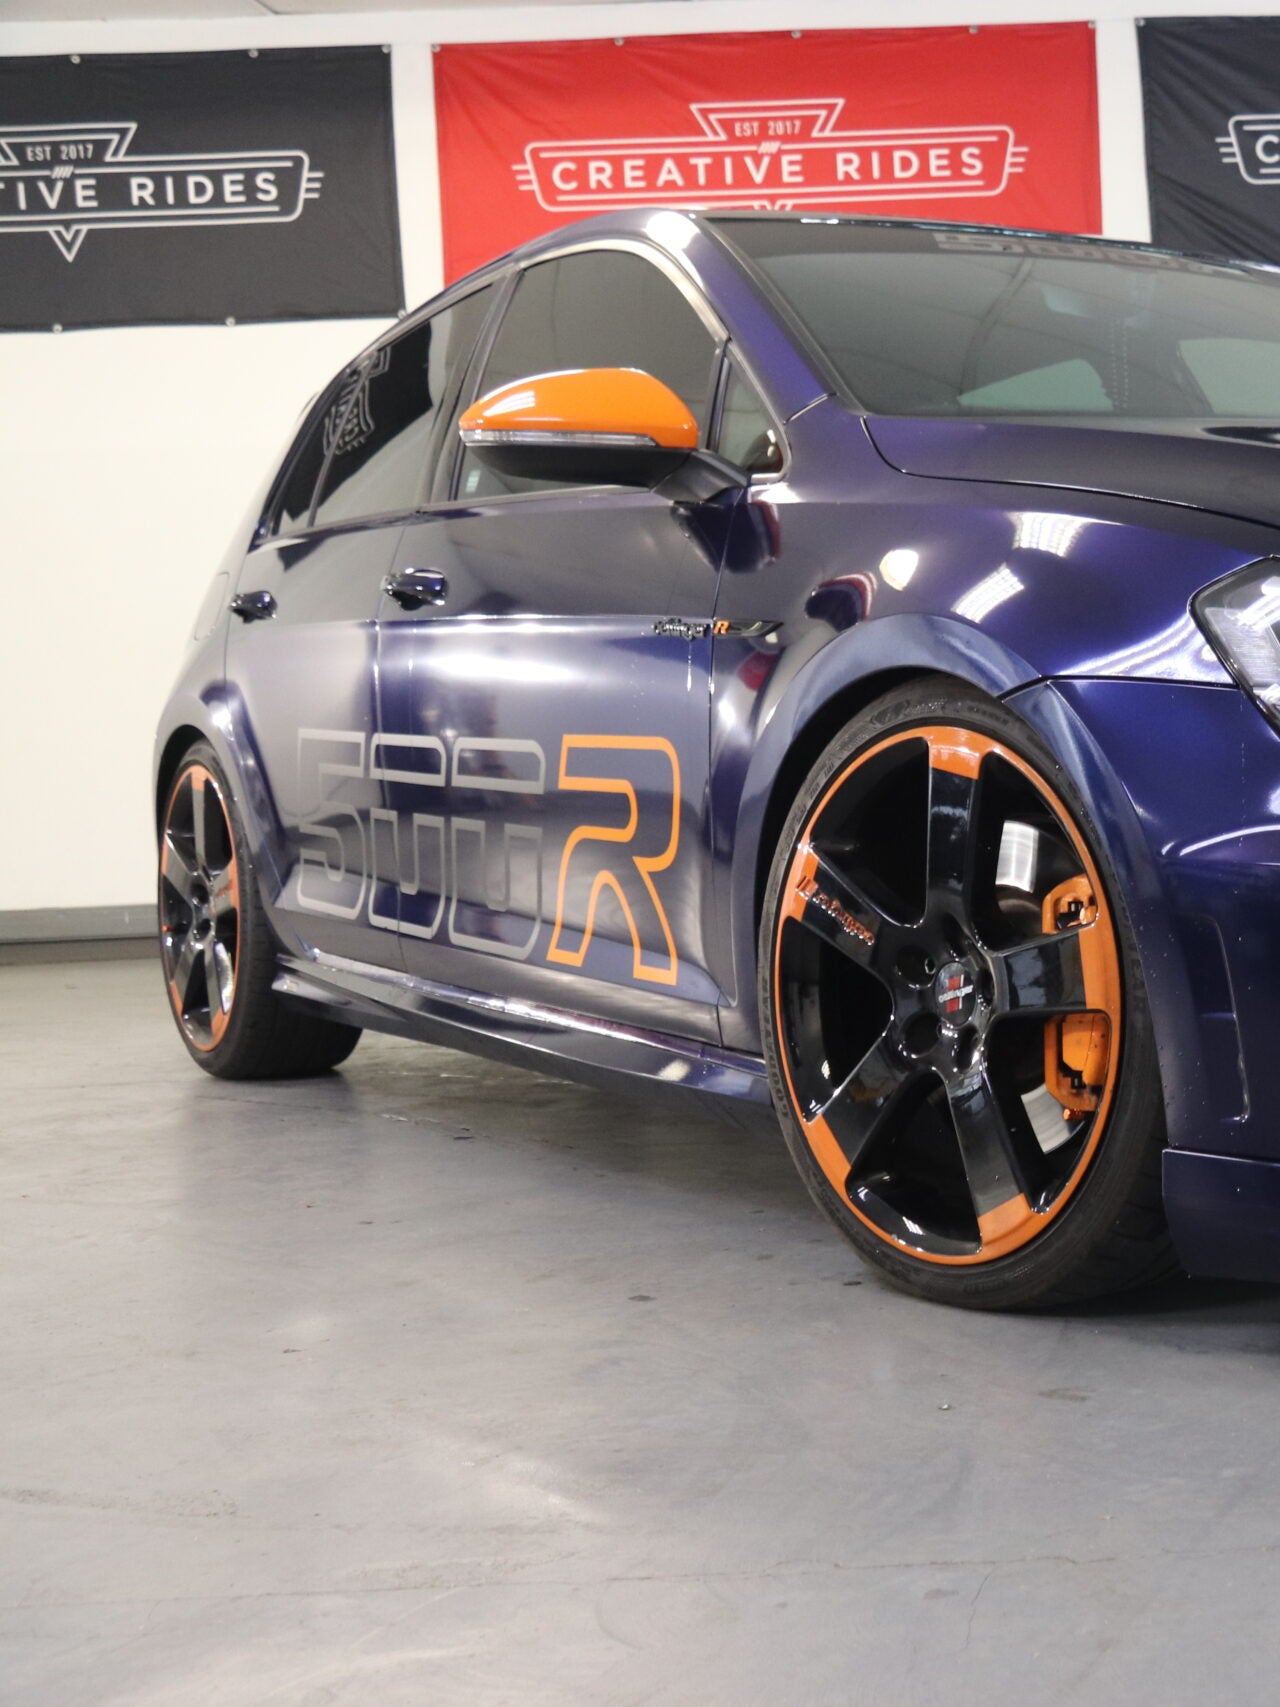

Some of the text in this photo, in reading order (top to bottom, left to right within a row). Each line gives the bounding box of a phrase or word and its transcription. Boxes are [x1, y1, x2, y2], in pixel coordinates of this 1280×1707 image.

[734, 119, 802, 137] EST 2017
[25, 143, 94, 162] EST 2017
[551, 146, 985, 192] CREATIVE RIDES
[0, 171, 279, 211] IVE RIDES
[296, 727, 682, 986] 500R
